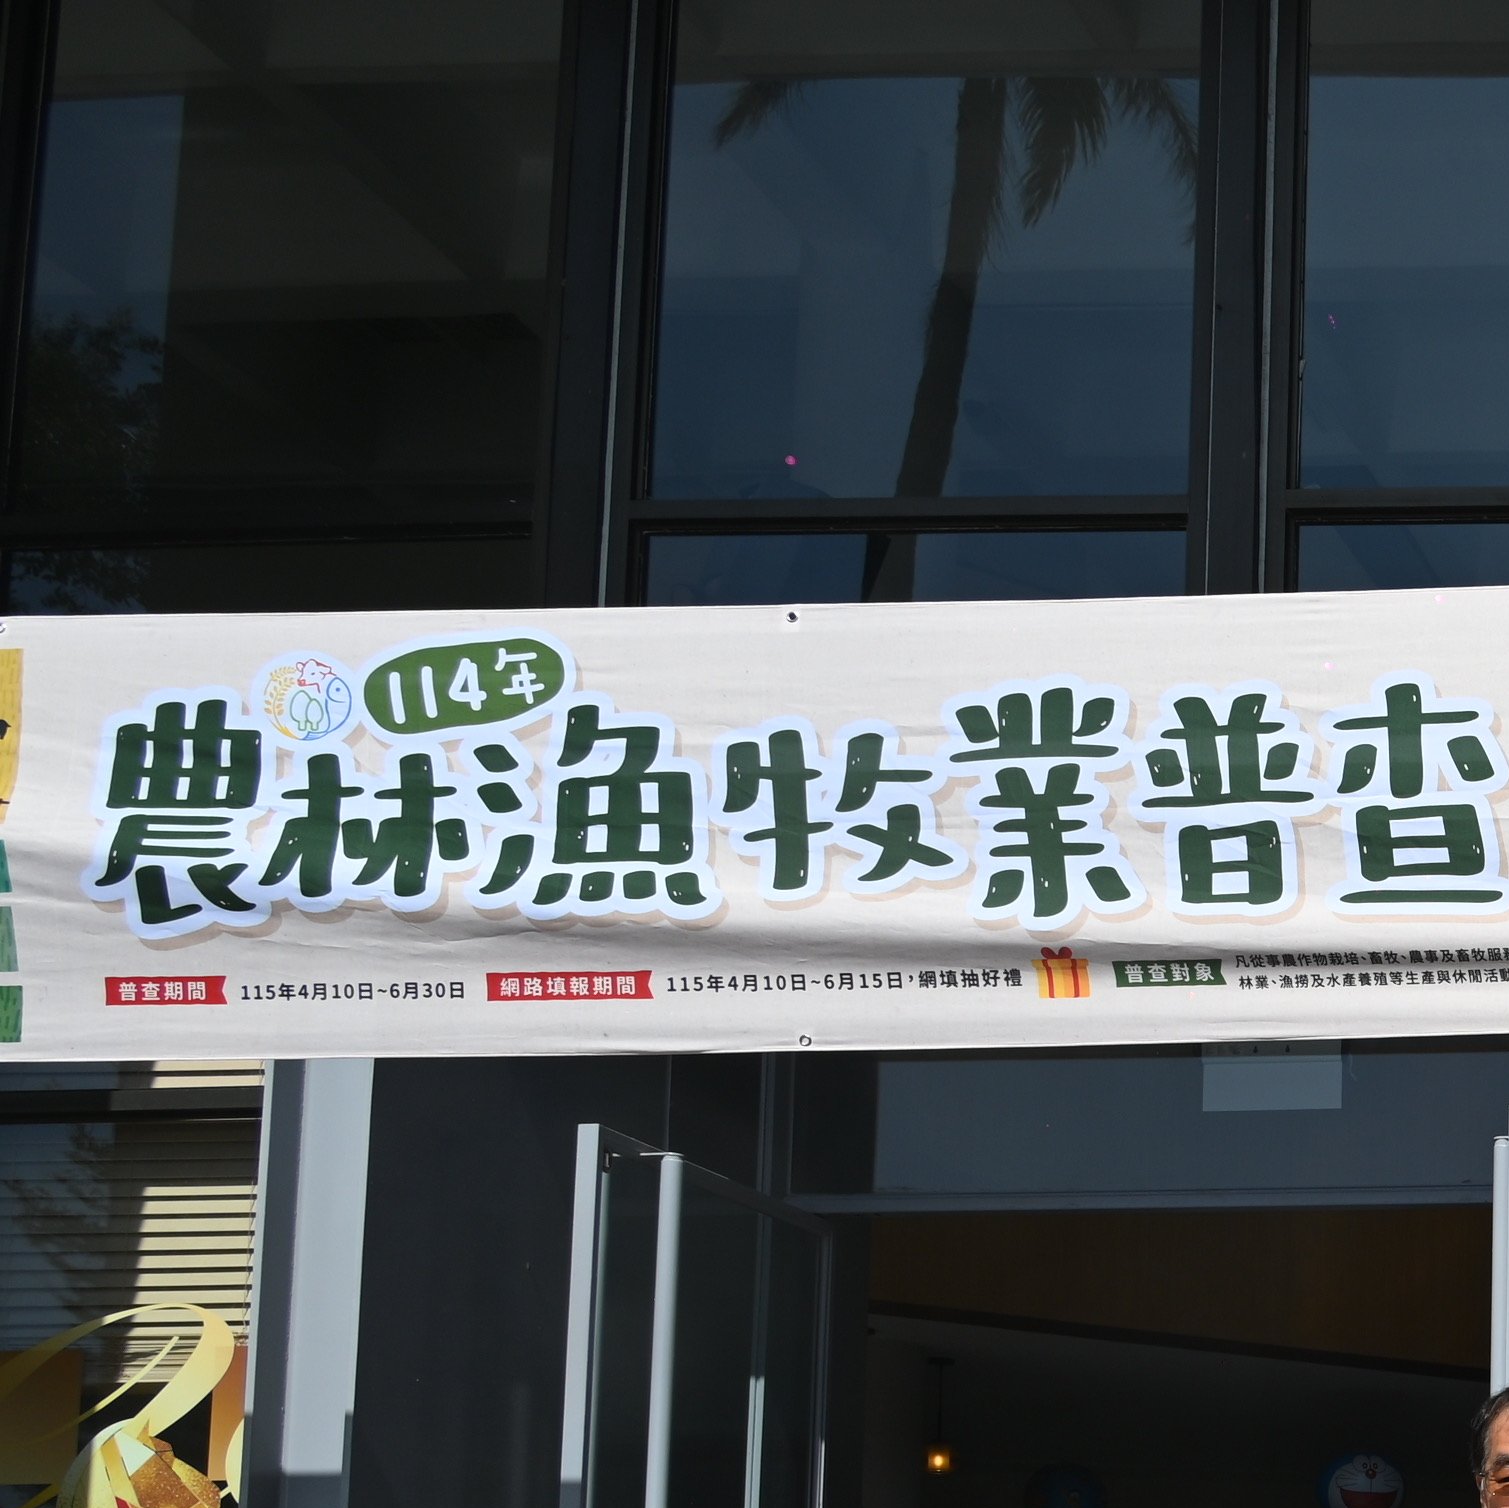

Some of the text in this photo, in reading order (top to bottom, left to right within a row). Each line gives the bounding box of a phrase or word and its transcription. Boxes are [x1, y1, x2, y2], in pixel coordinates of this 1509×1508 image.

[390, 647, 545, 727] 114年
[96, 682, 1503, 925] 農林漁牧業普查
[1124, 961, 1215, 985] 普查對象
[118, 980, 207, 1002] 普查期間
[240, 980, 466, 1002] 115年4月10日~6月30日
[499, 975, 637, 998] 網路填報期間
